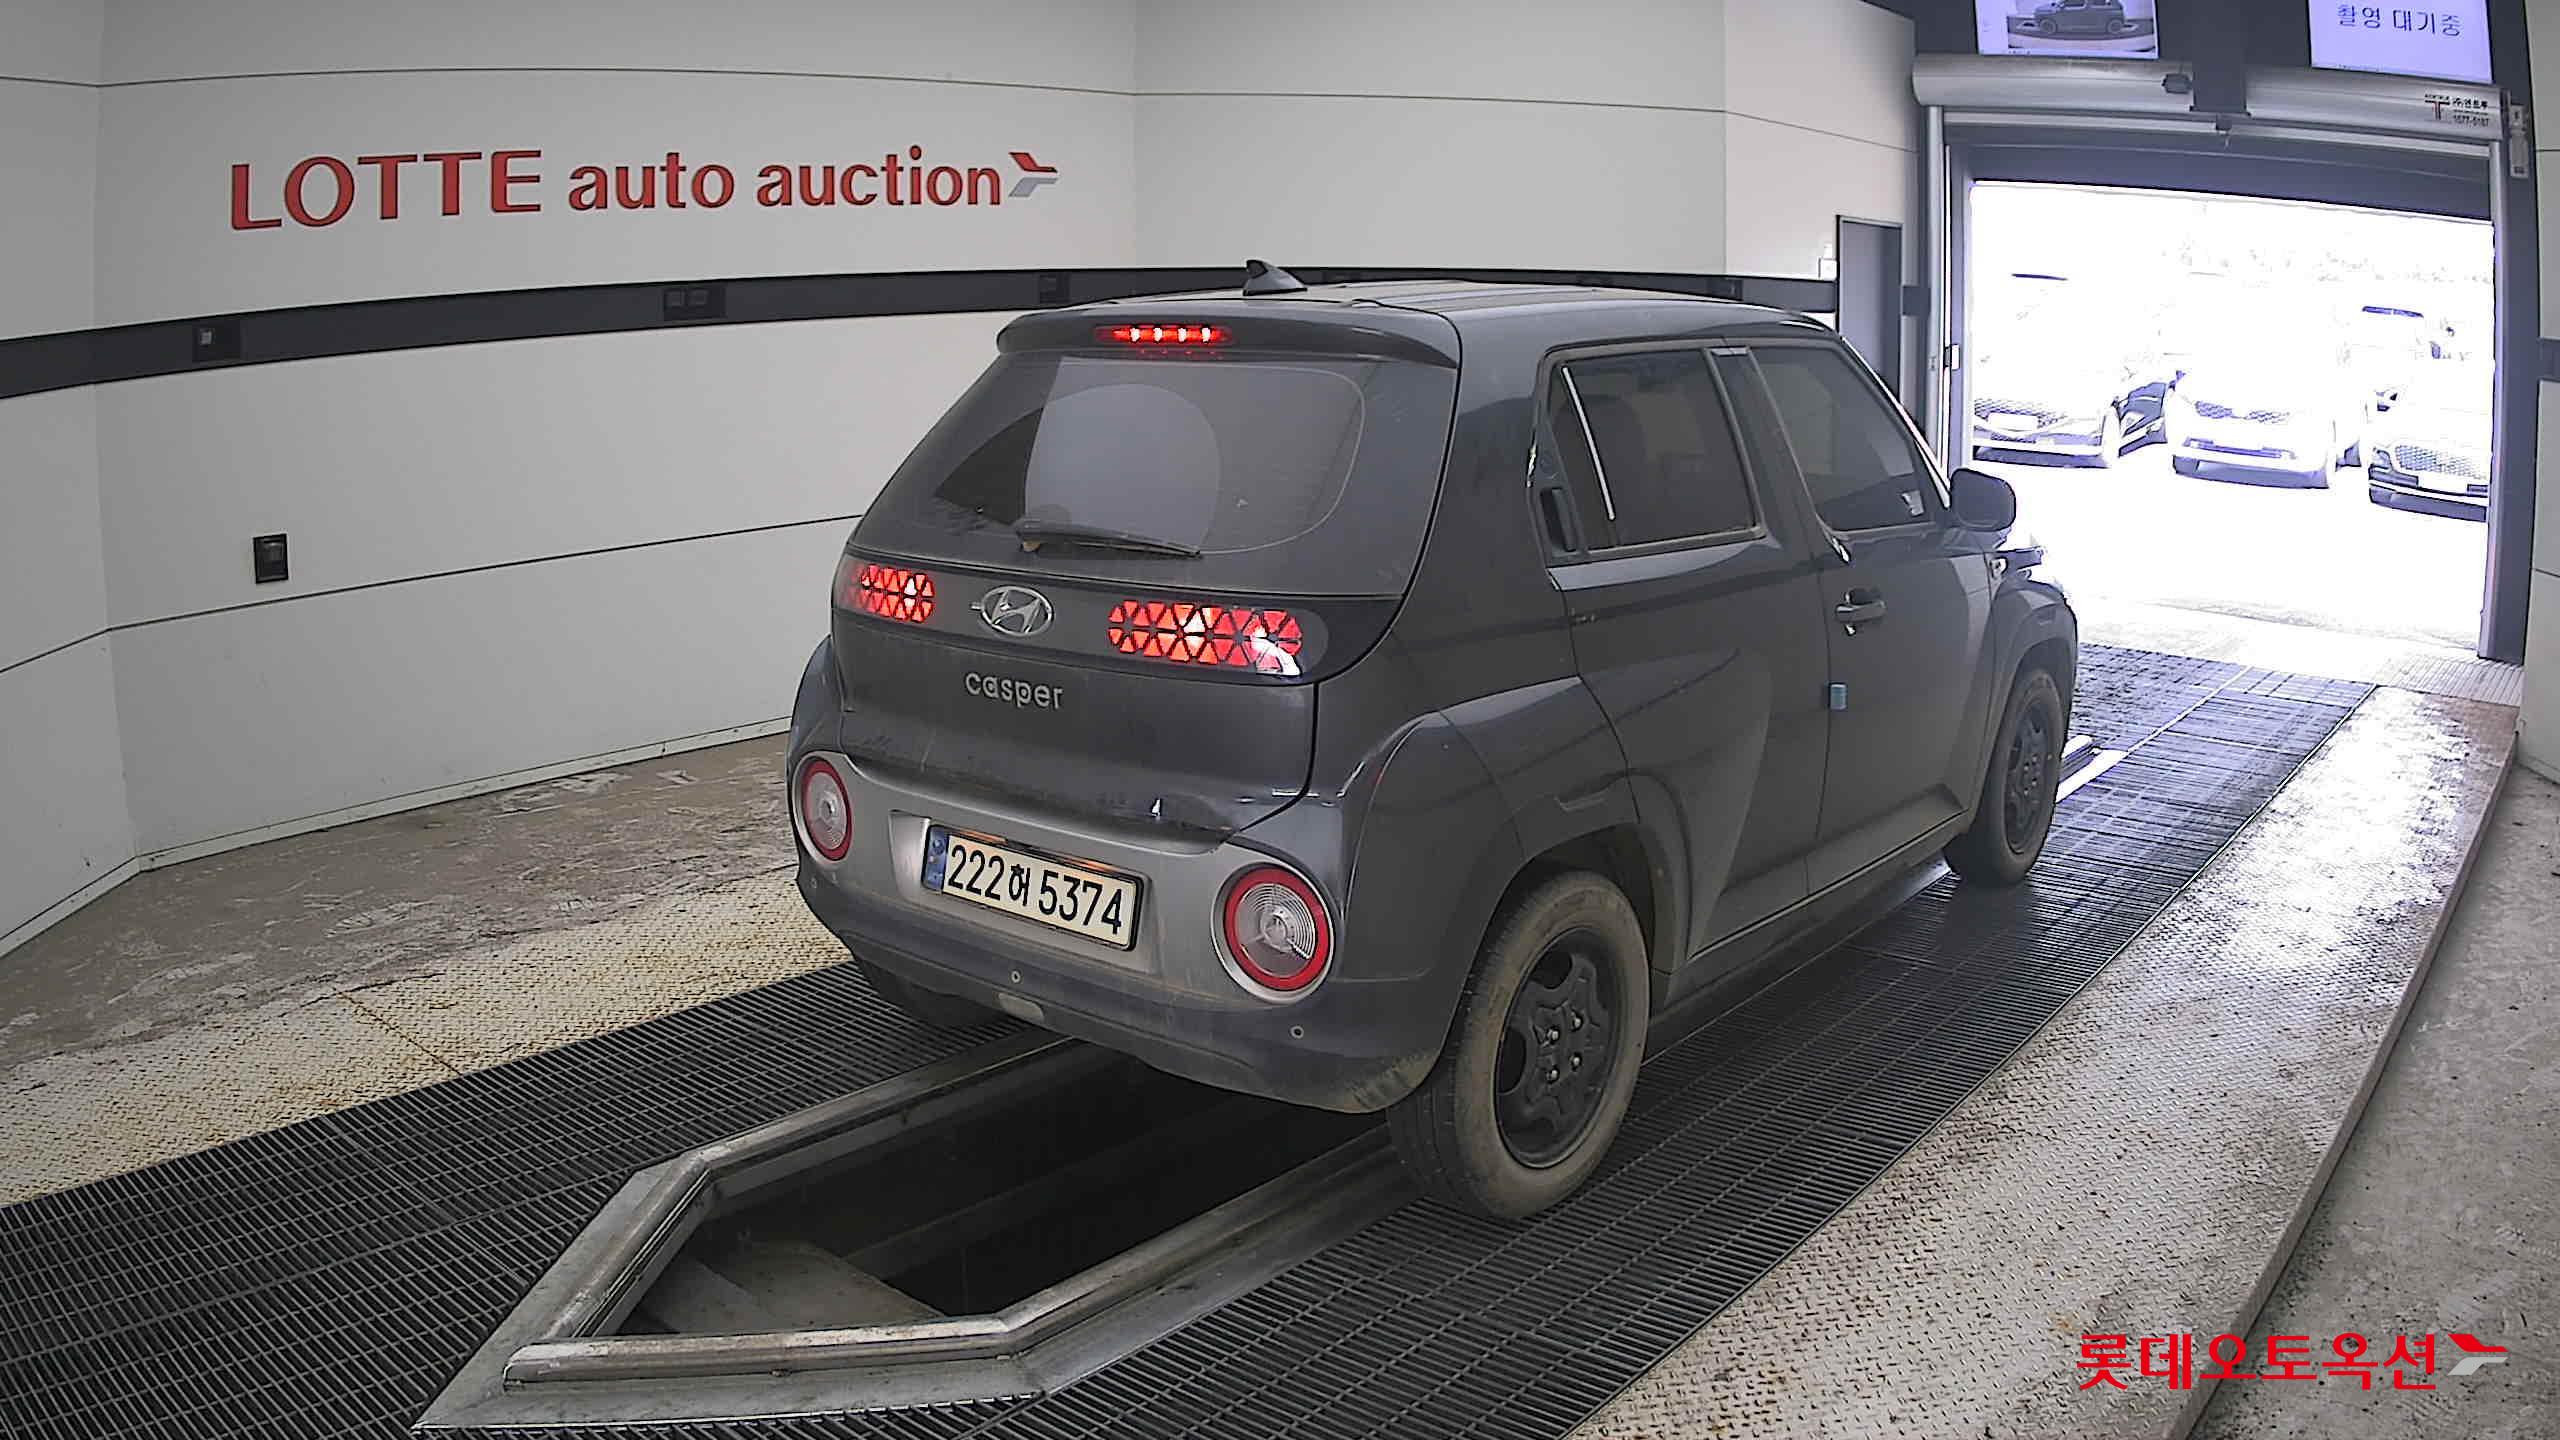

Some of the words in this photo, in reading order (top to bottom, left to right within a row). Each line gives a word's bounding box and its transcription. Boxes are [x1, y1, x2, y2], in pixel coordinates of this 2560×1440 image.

[2337, 4, 2381, 29] 촬영
[2392, 9, 2461, 37] 대기중
[230, 150, 541, 231] LOTTE
[568, 152, 736, 209] auto
[756, 146, 1003, 208] auction
[965, 672, 1063, 709] casper
[948, 844, 1031, 907] 222허
[1038, 869, 1122, 935] 5374
